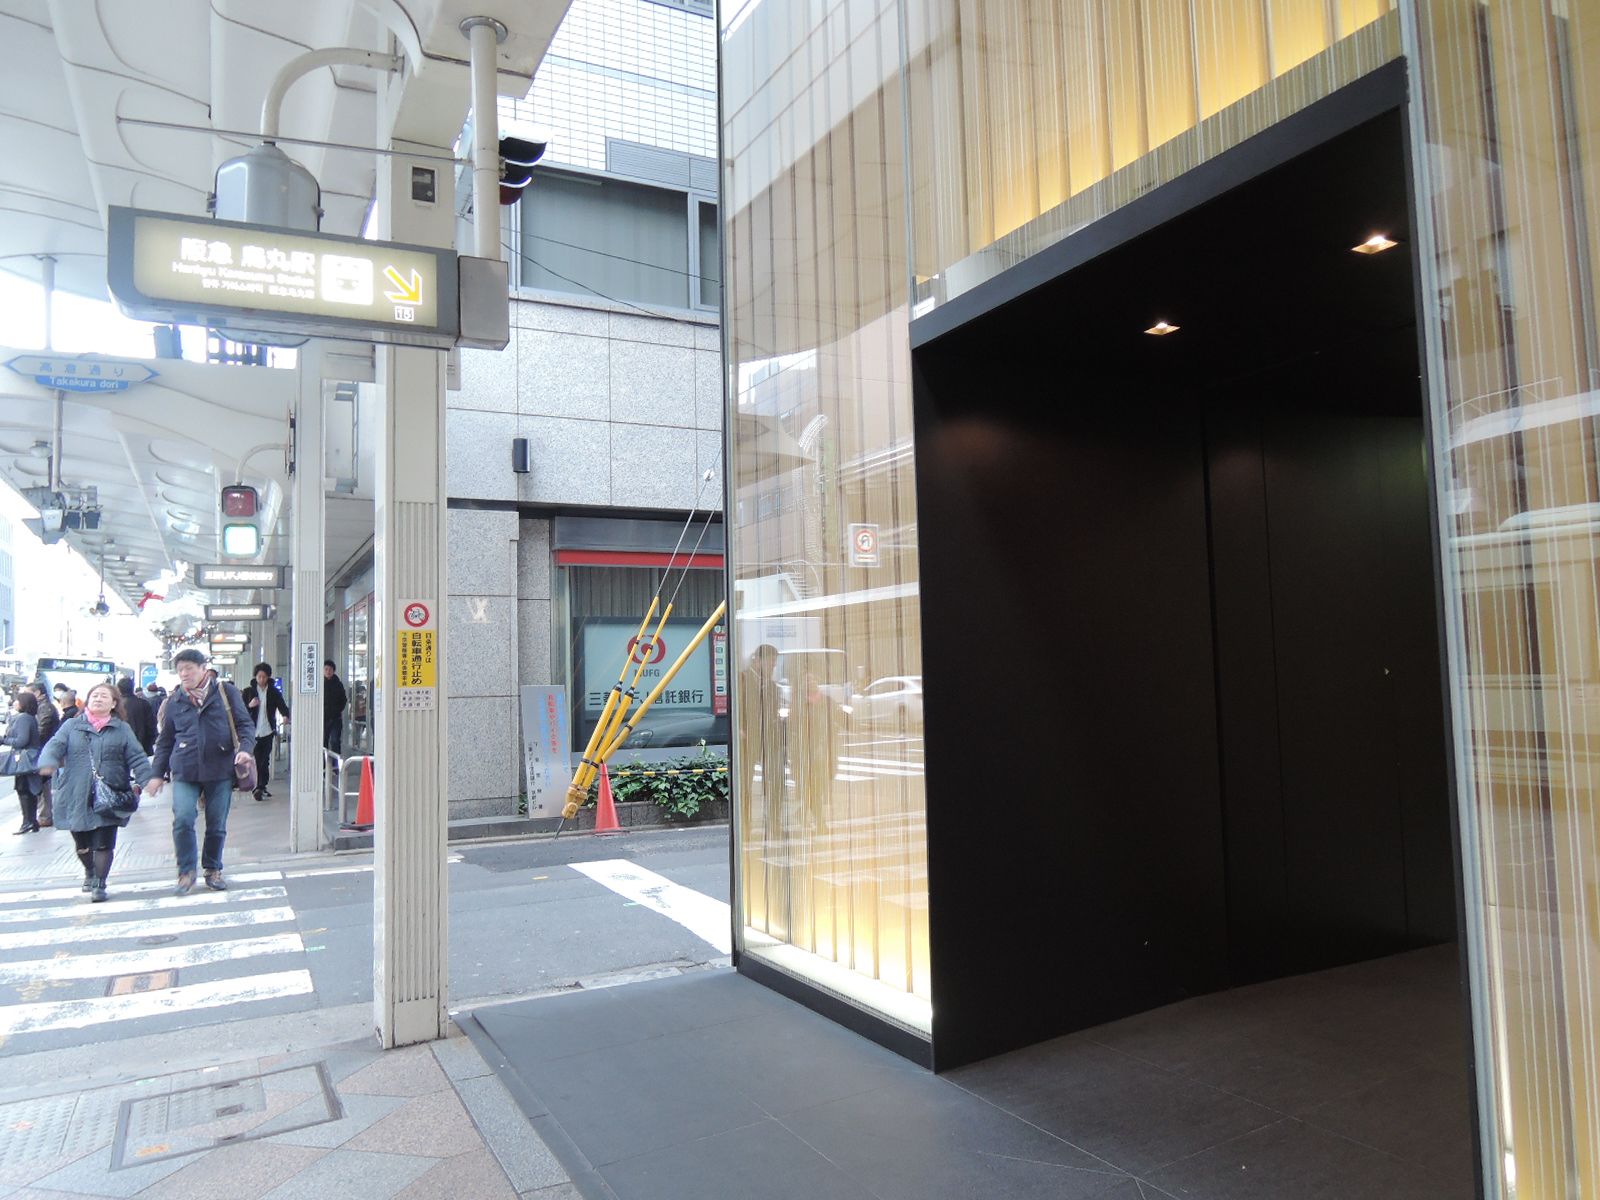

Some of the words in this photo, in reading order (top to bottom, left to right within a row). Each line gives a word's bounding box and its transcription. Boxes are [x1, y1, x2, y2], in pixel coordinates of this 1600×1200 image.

[49, 376, 97, 388] Takakura
[99, 379, 119, 389] dori
[411, 632, 422, 685] 自転車通行止め
